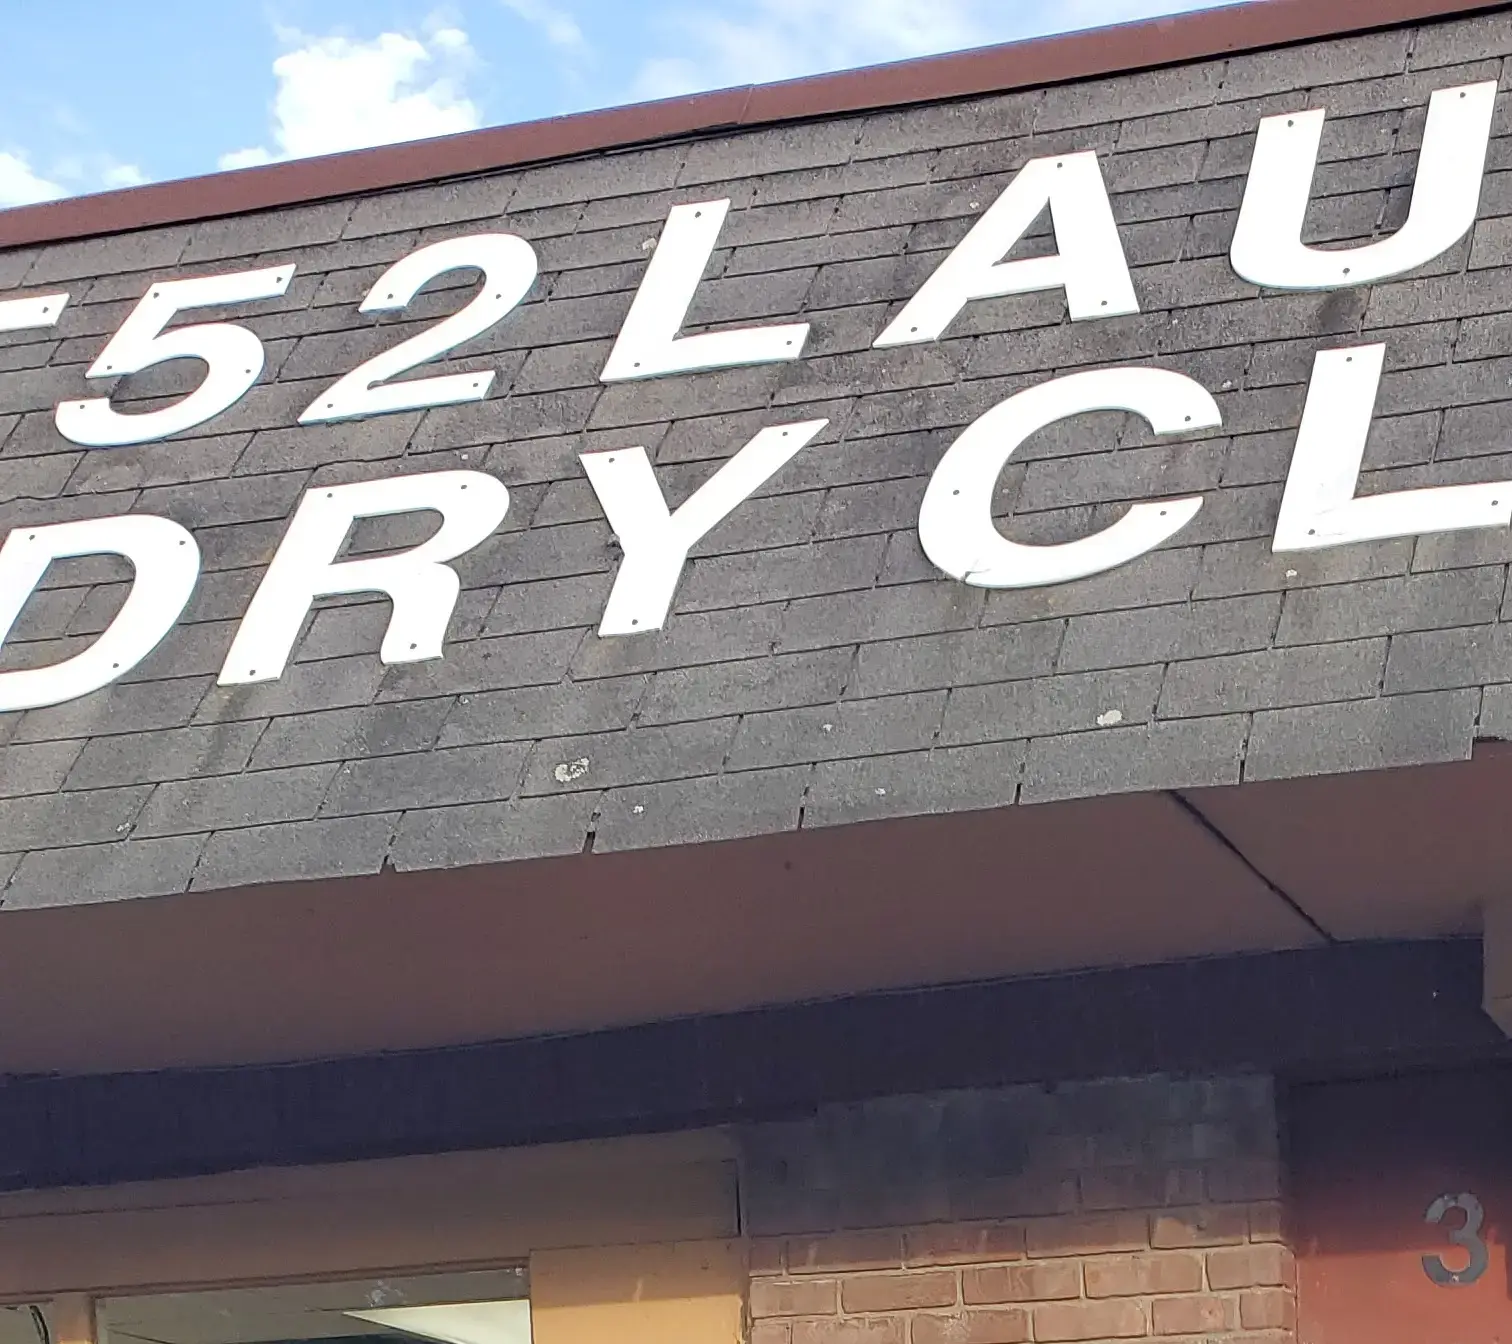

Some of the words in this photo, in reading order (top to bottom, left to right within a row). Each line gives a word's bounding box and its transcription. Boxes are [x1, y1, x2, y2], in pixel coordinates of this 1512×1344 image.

[0, 232, 538, 447] 52
[0, 418, 829, 712] DRY
[1422, 1193, 1489, 1287] 3
